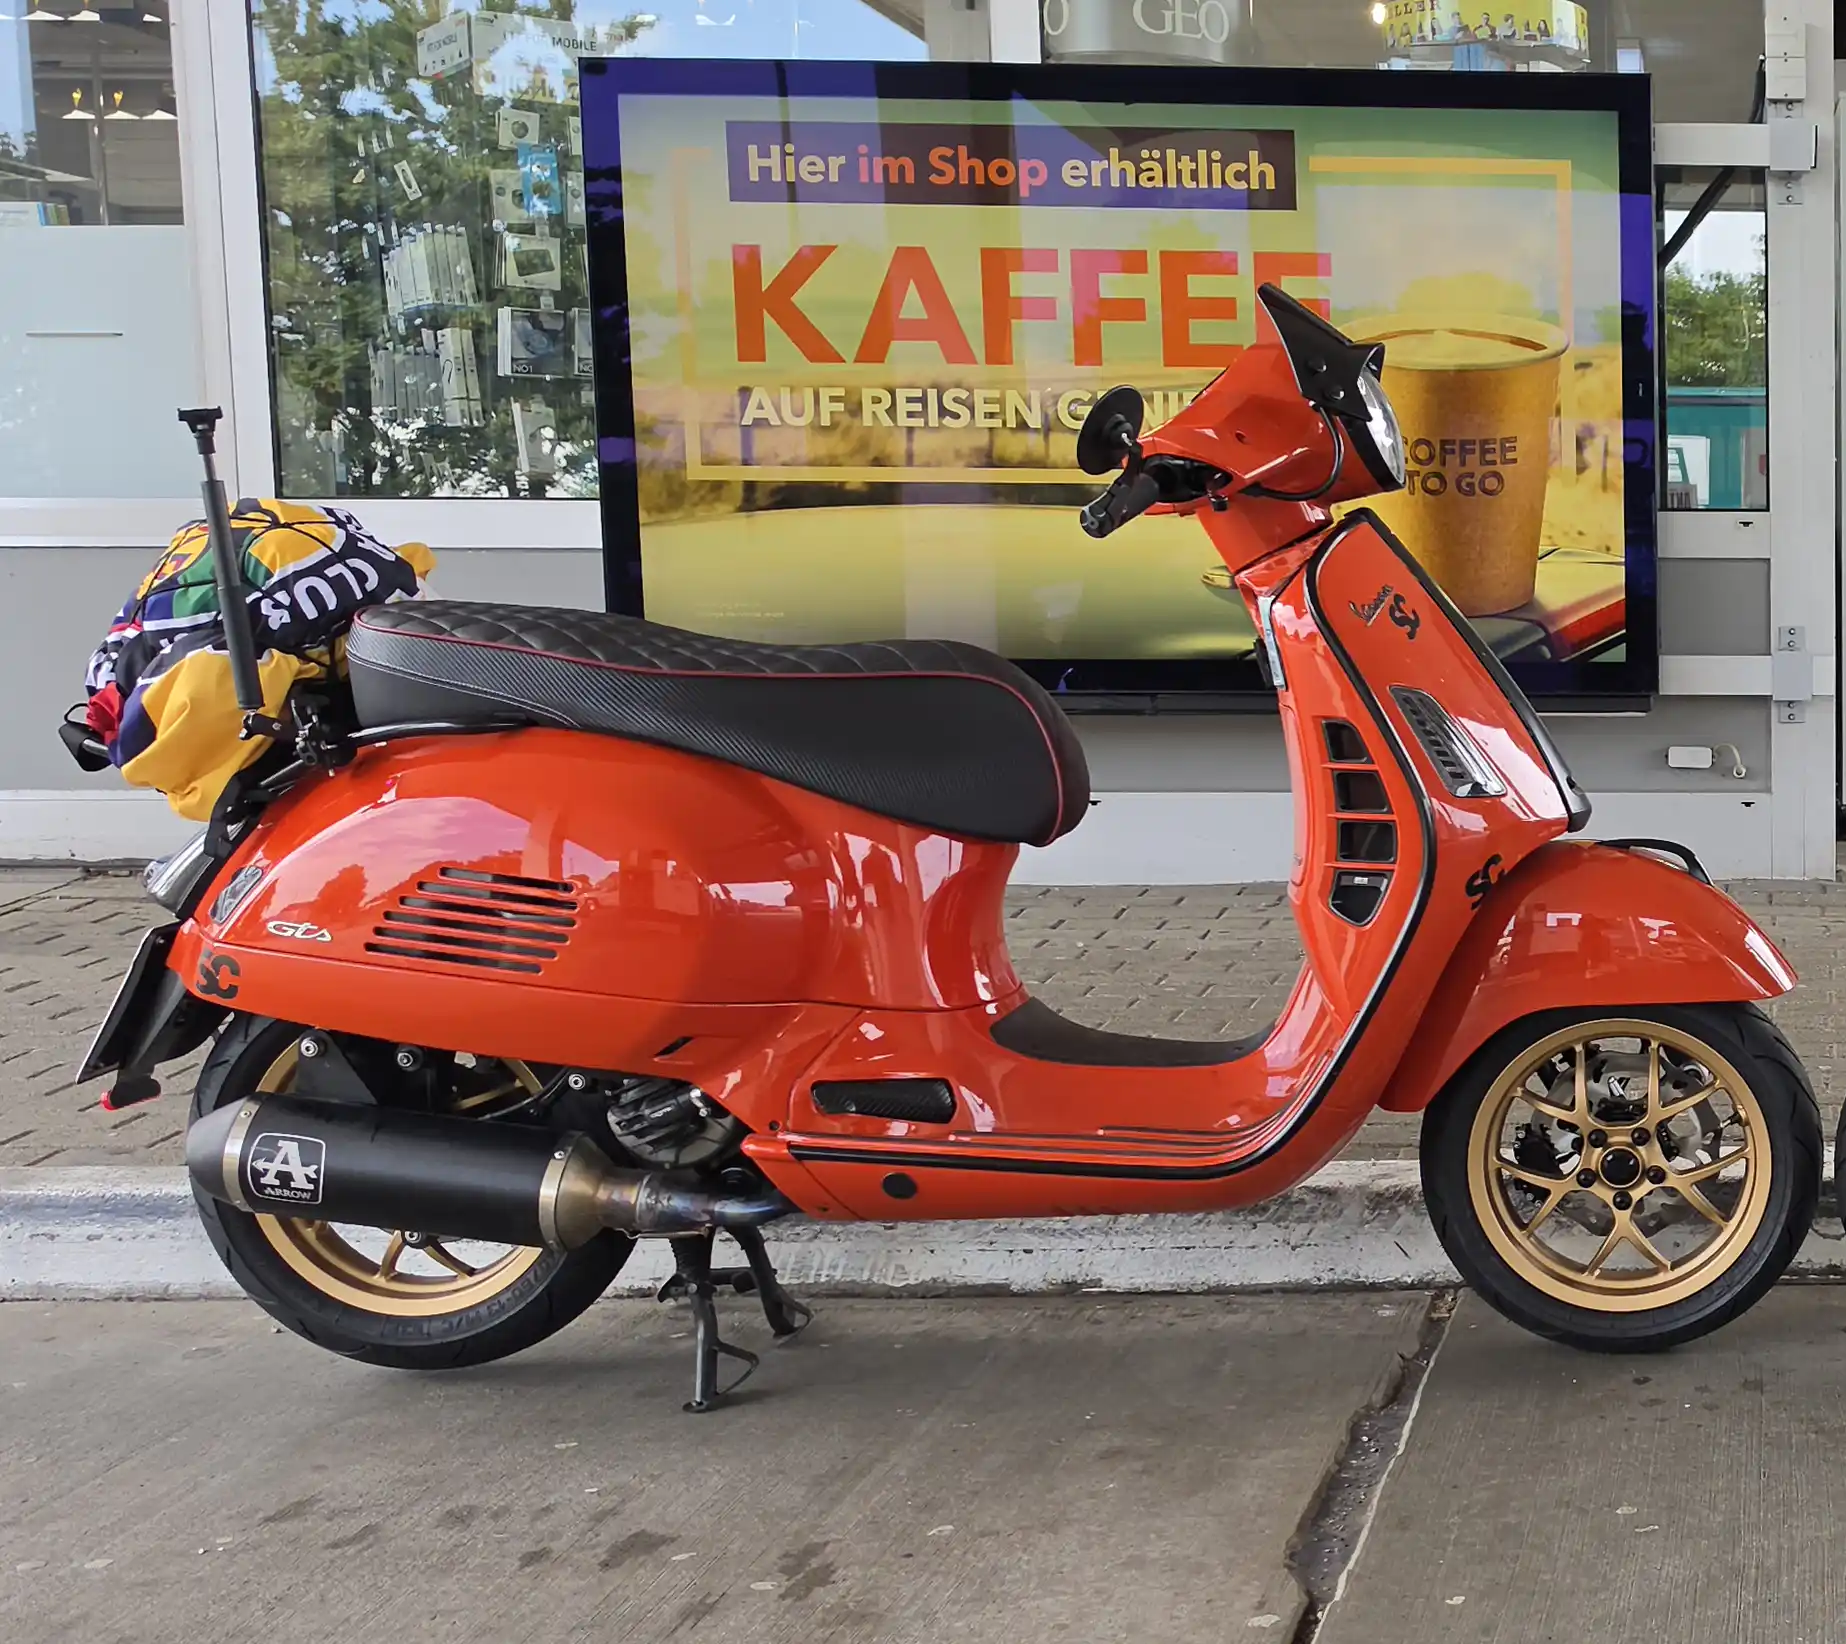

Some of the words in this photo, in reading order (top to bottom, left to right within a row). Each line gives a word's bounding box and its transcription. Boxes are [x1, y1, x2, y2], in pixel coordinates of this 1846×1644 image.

[1133, 0, 1229, 43] GEO
[551, 36, 597, 52] MOBILE
[748, 144, 846, 183] Hier
[858, 145, 915, 184] im
[928, 146, 1048, 197] Shop
[1061, 148, 1276, 191] erhältlich
[741, 386, 846, 427] AUF
[861, 388, 1041, 429] REISEN
[1057, 389, 1200, 430] GNI
[1405, 470, 1447, 496] TO
[1455, 470, 1505, 497] GO
[263, 1187, 312, 1200] ARROW
